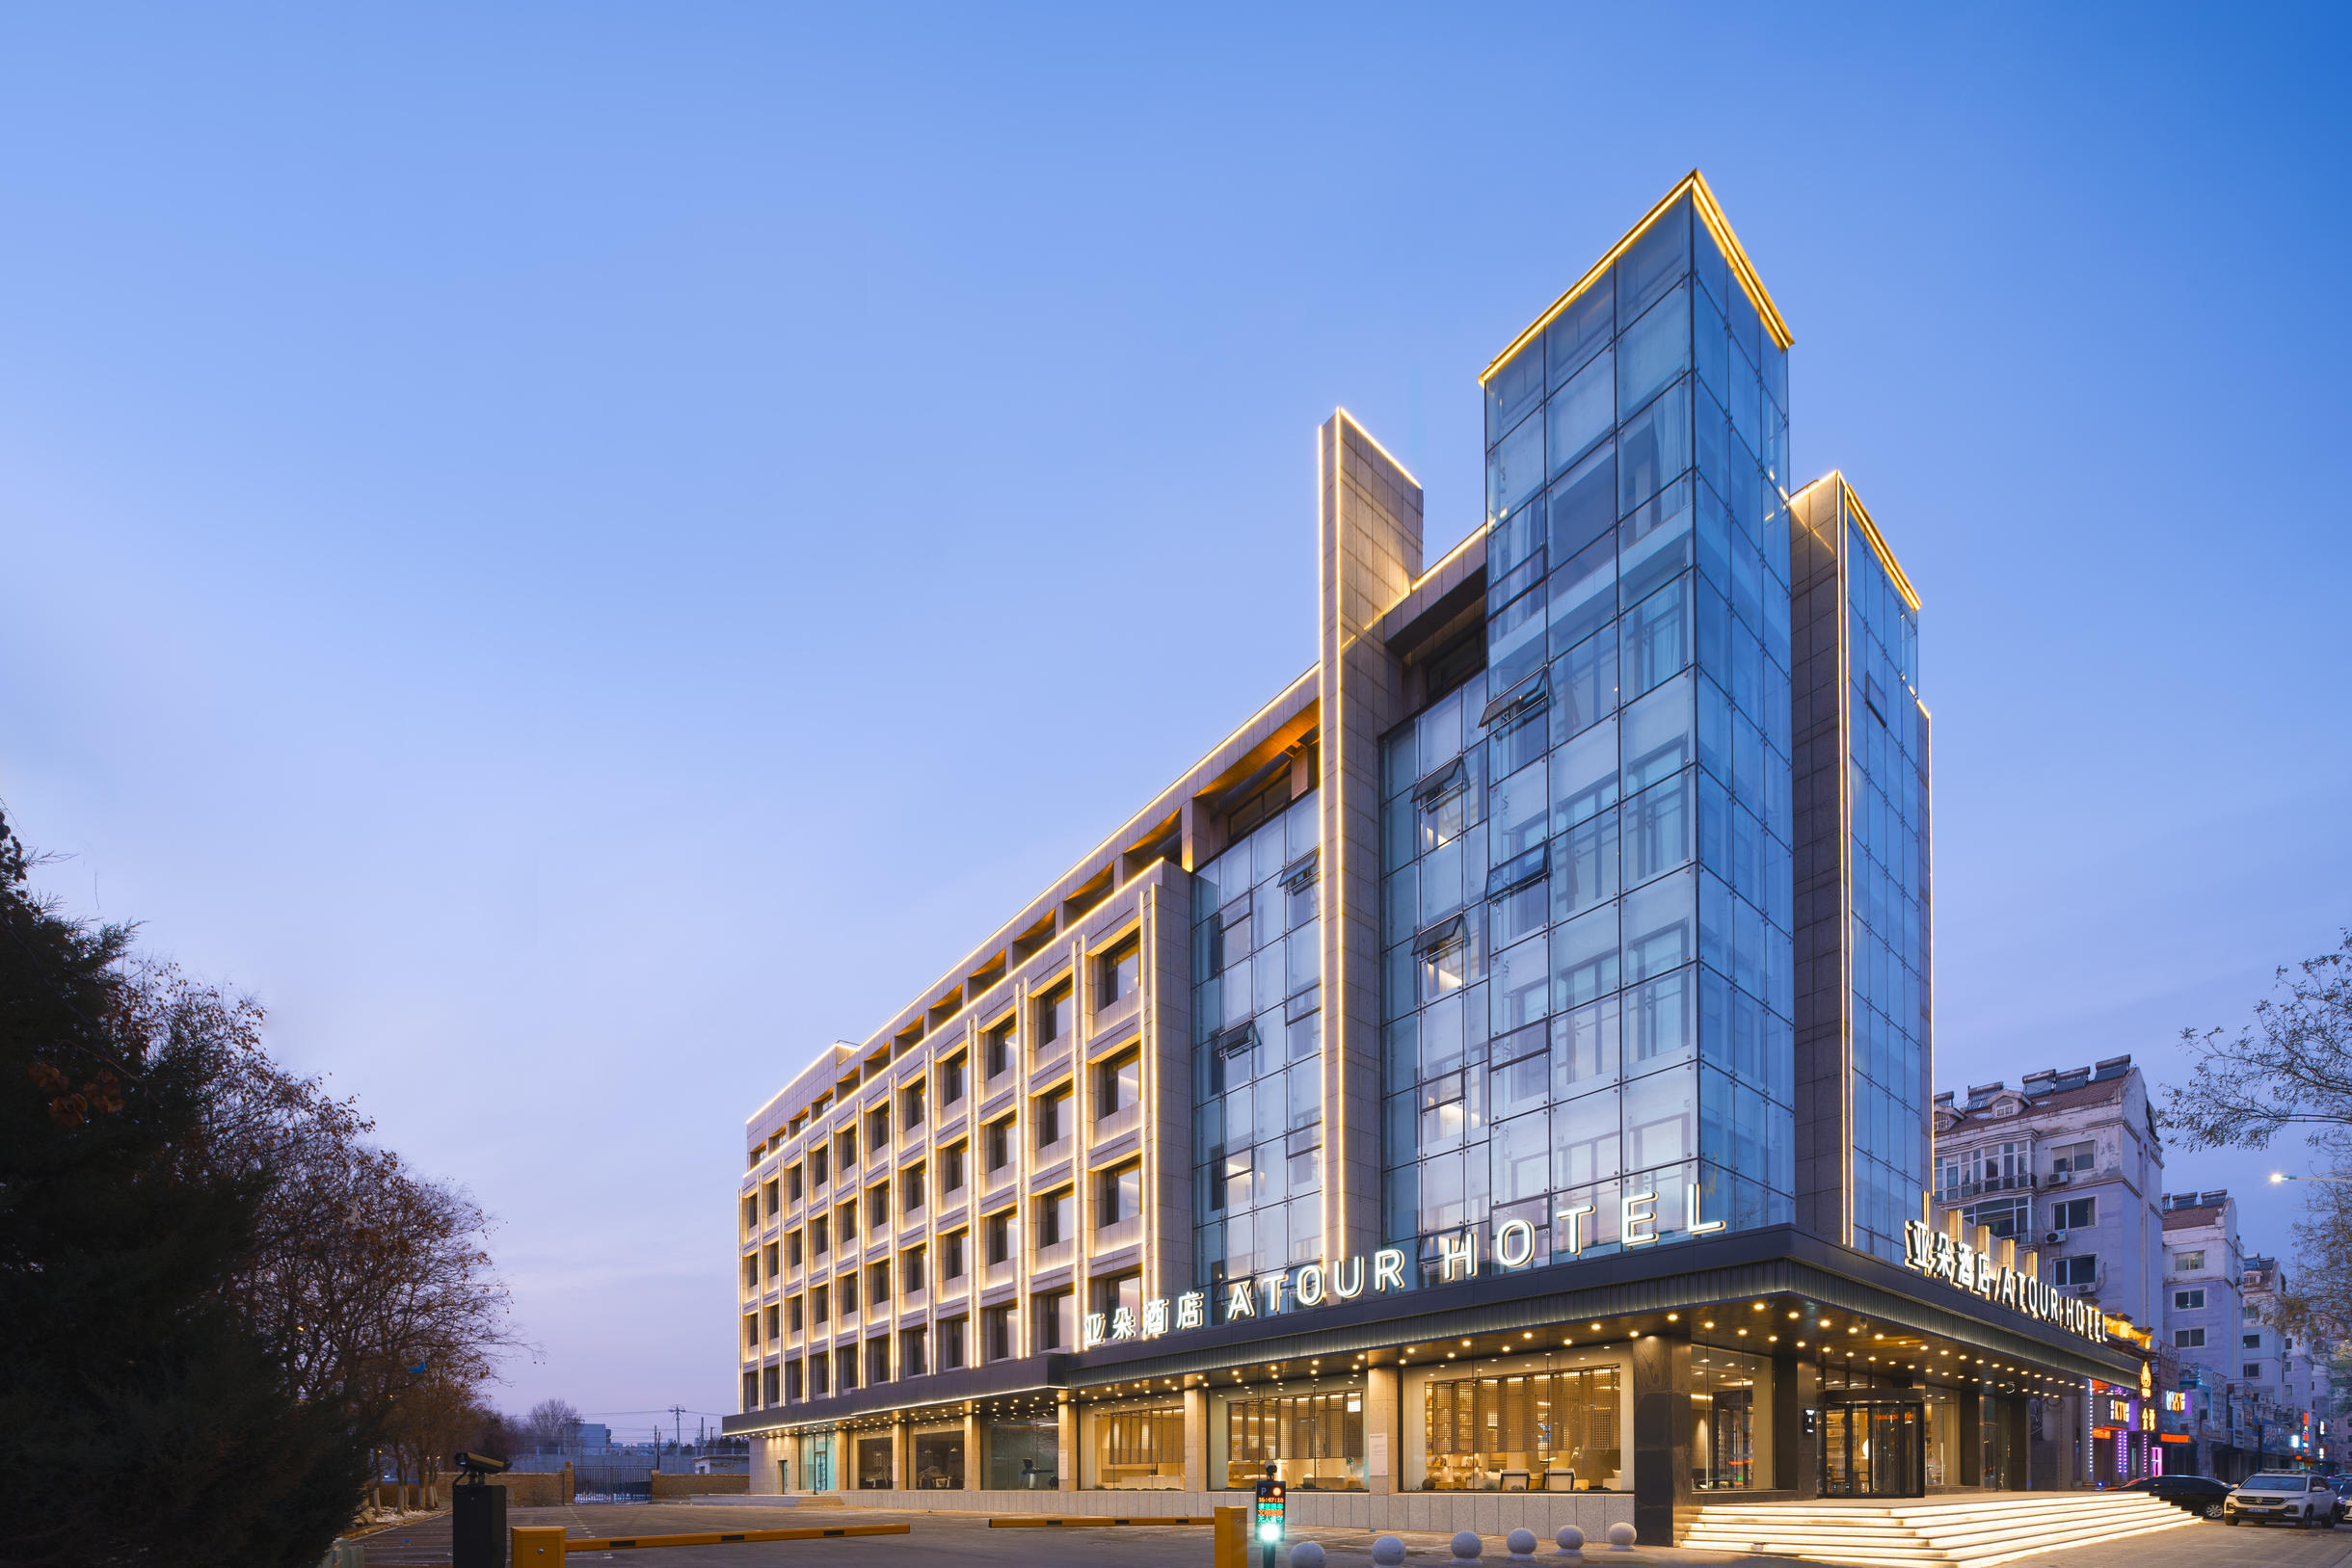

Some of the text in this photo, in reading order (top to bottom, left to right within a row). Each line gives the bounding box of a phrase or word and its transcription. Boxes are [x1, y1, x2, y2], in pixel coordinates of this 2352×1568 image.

[1227, 1183, 1726, 1319] ATOUR HOTEL
[1905, 1219, 1991, 1294] 亚朵酒店
[1083, 1291, 1204, 1346] 亚朵酒店
[1999, 1266, 2108, 1342] ATOUR HOTEL
